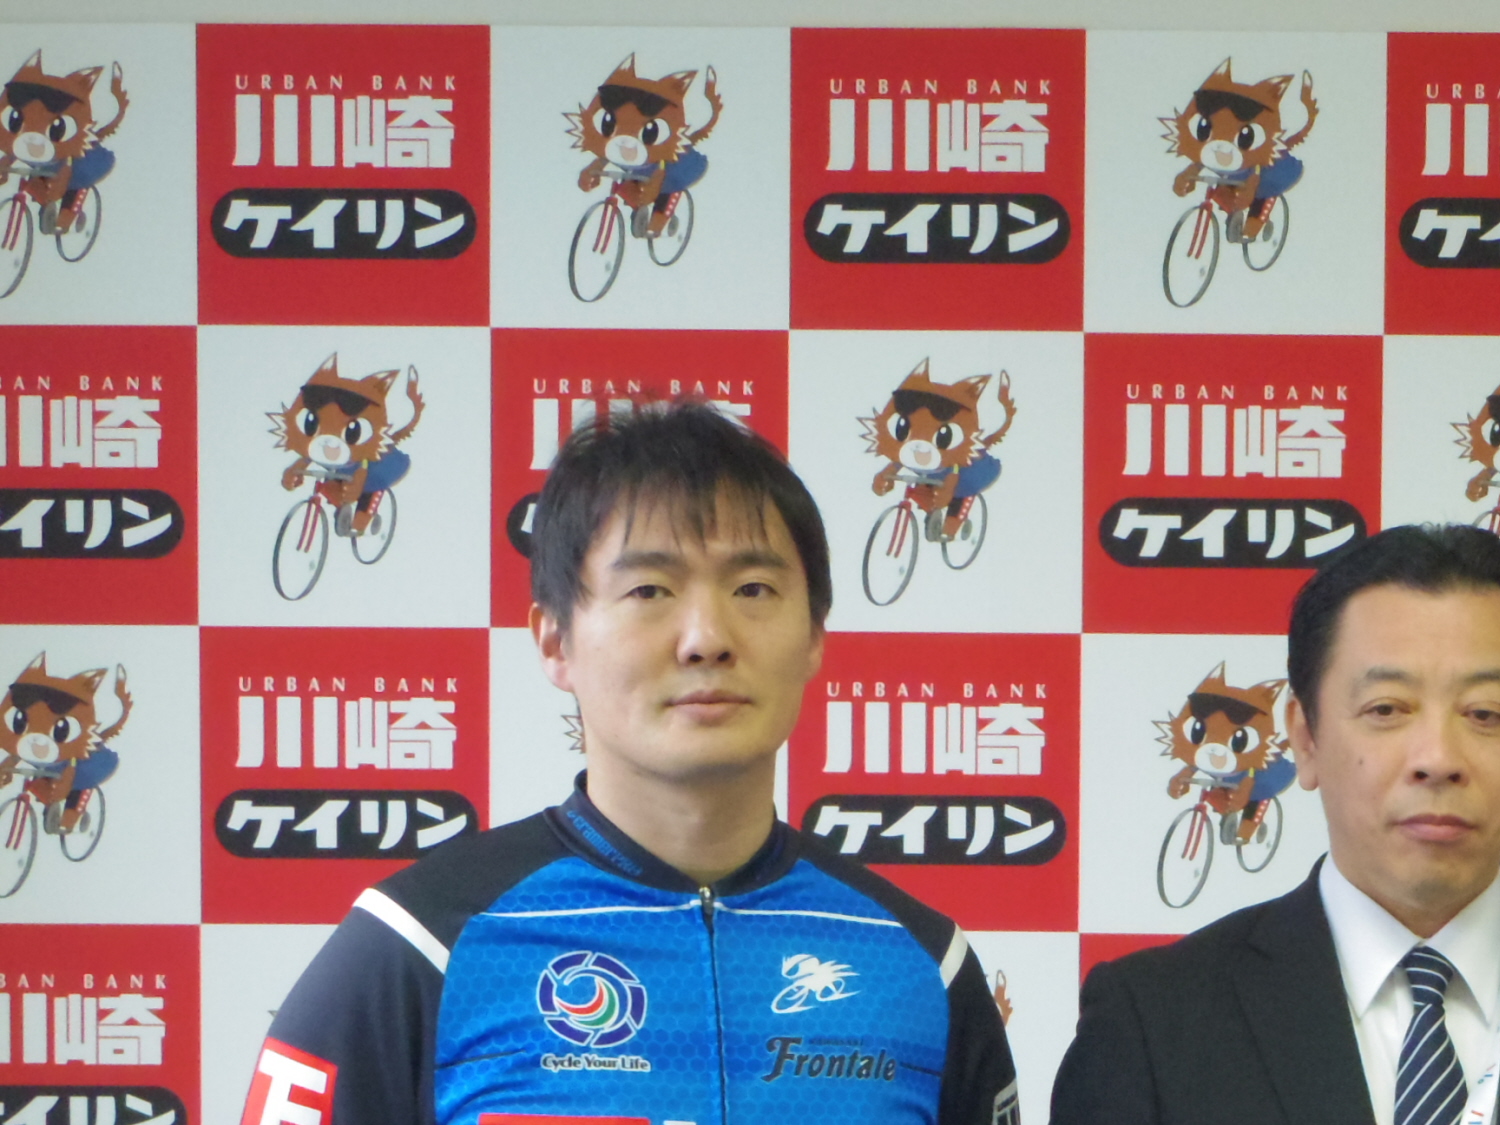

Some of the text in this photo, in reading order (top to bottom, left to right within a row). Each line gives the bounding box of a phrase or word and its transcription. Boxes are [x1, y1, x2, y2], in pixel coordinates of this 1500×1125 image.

[236, 75, 455, 90] URBAN BANK
[831, 79, 1049, 94] URBAN BANK
[233, 95, 454, 168] 川崎
[827, 99, 1048, 172] 川崎
[224, 198, 464, 249] ケイリン
[817, 202, 1058, 253] ケイリン
[80, 376, 162, 390] BANK
[534, 379, 753, 395] URBAN BANK
[1127, 384, 1347, 400] URBAN BANK
[1123, 404, 1346, 477] 川崎
[0, 498, 171, 548] イリン
[1113, 508, 1354, 558] ケイリン
[239, 677, 457, 692] URBAN BANK
[827, 682, 1046, 698] URBAN BANK
[236, 698, 456, 769] 川崎
[823, 704, 1045, 775] 川崎
[227, 799, 467, 849] ケイリン
[814, 804, 1054, 855] ケイリン
[84, 974, 166, 989] BANK
[541, 1054, 650, 1072] Cycle Your Life
[760, 1036, 897, 1082] Frontale
